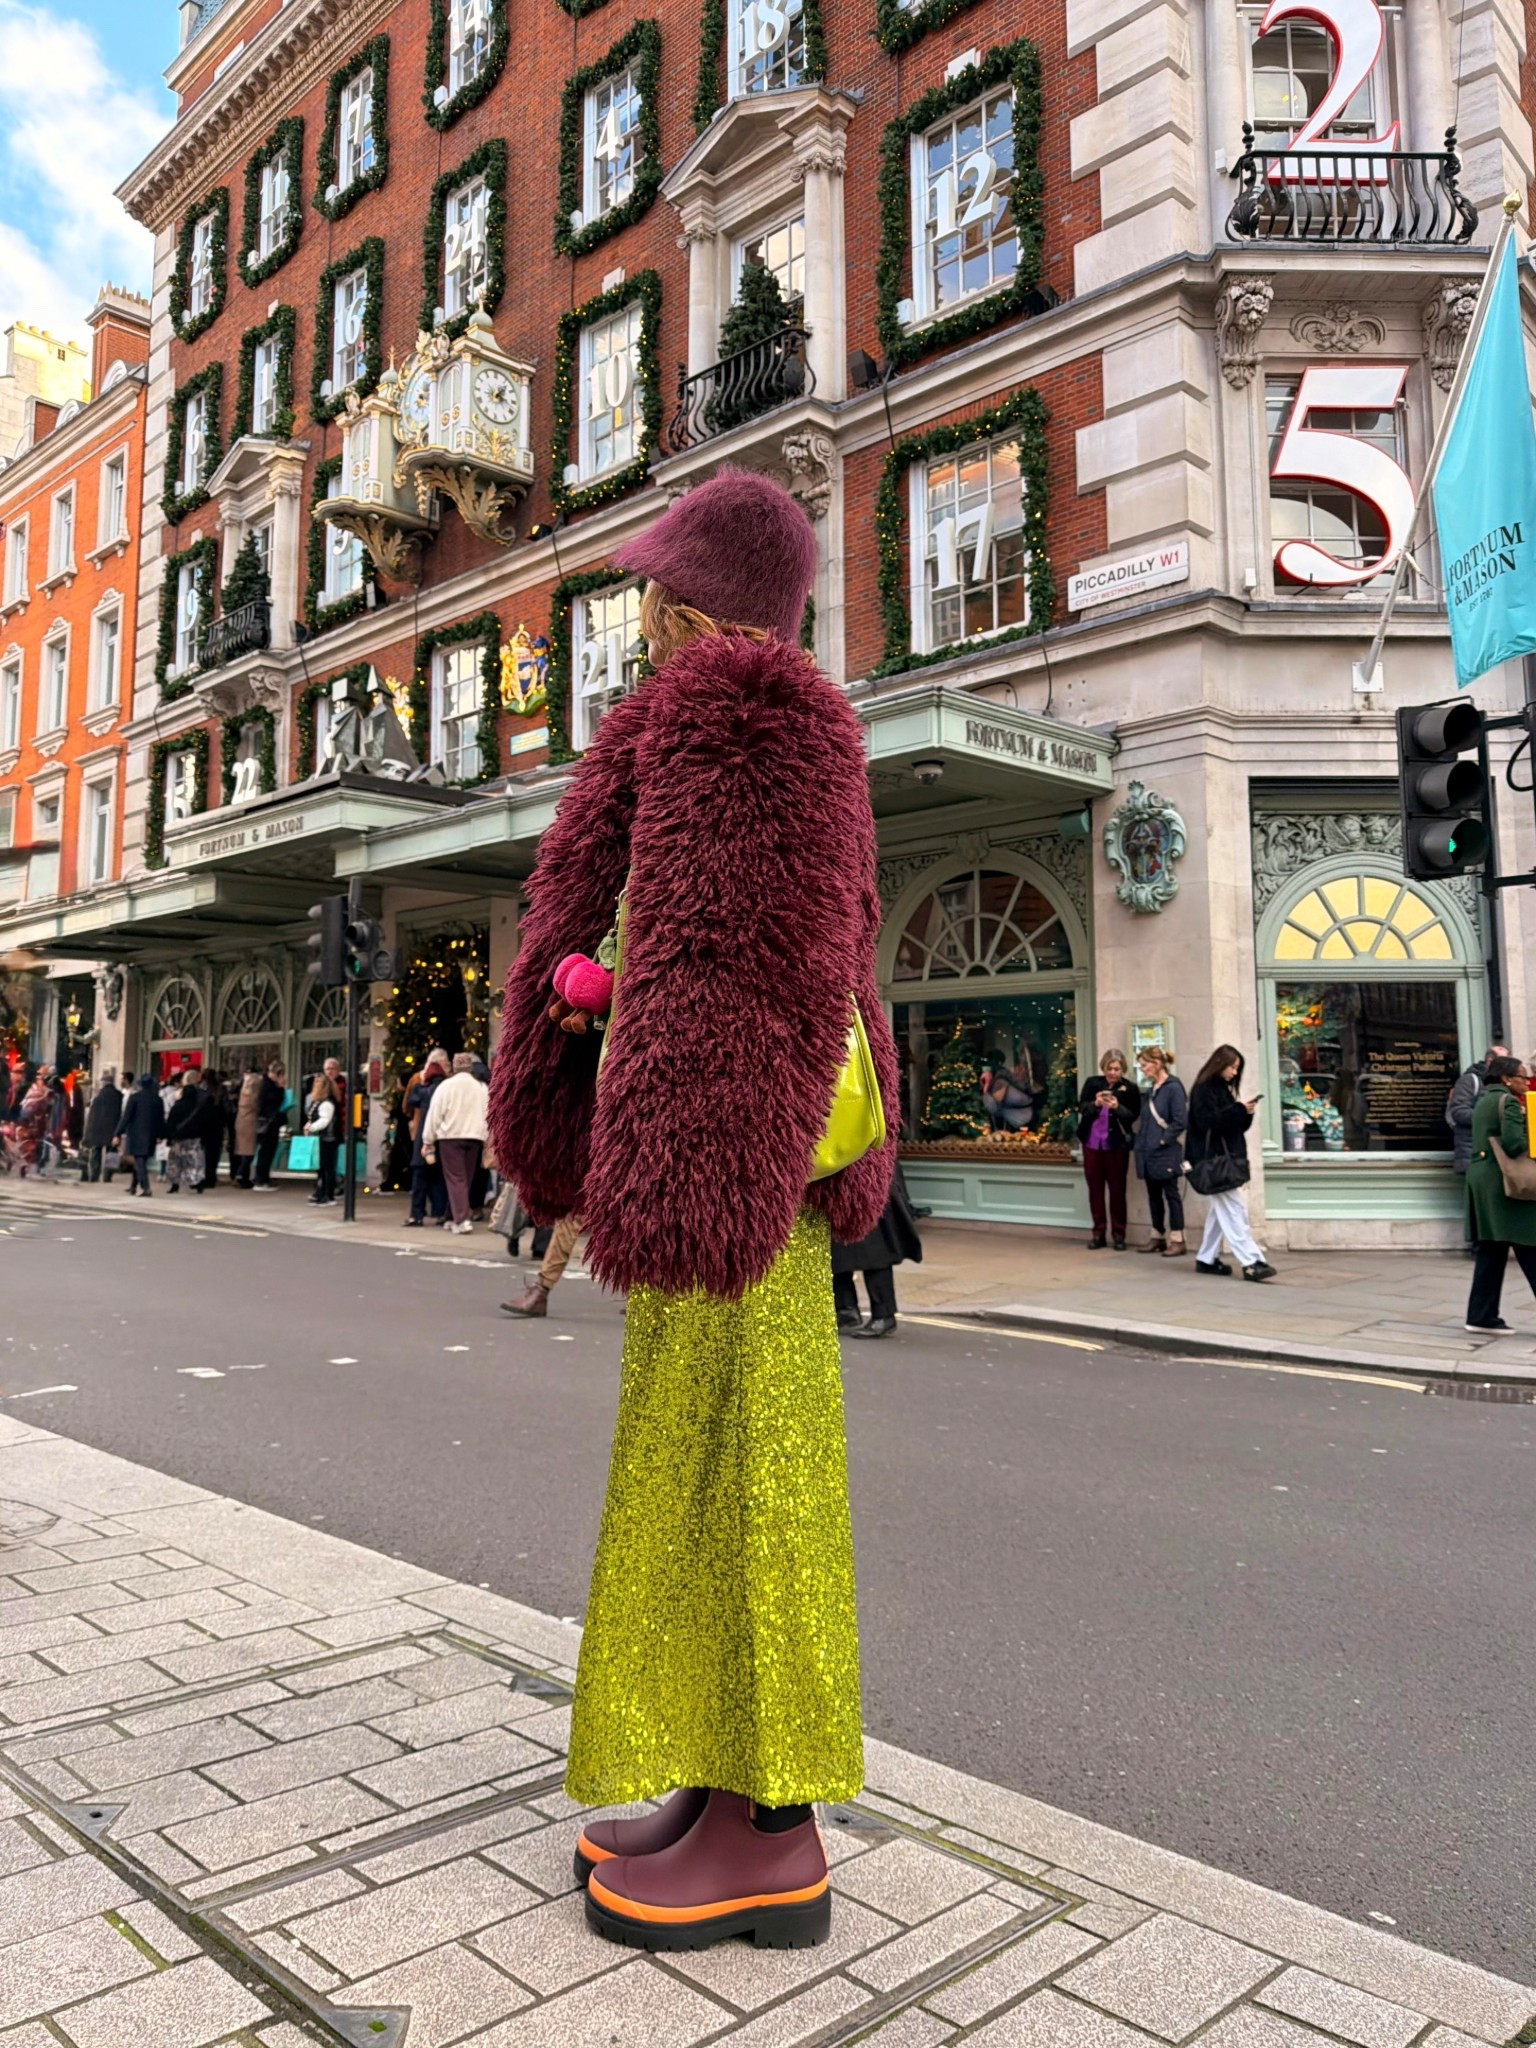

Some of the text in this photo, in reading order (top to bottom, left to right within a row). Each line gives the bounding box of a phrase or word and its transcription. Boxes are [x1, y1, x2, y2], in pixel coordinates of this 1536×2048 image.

[347, 94, 364, 146] 7
[1258, 0, 1400, 187] 2
[595, 106, 623, 162] 4
[928, 151, 997, 243] 12
[443, 204, 485, 274] 24
[334, 296, 364, 352] 16
[259, 362, 273, 405] 1
[585, 351, 631, 420] 10
[189, 413, 203, 456] 6
[1271, 365, 1418, 587] 5
[928, 502, 993, 592] 17
[1075, 550, 1180, 594] PICCADILLY W1
[1448, 521, 1526, 588] FORTNUM
[1462, 548, 1516, 601] MASON
[179, 588, 200, 634] 9
[1075, 580, 1146, 607] CITY OF WESTMINSTER
[580, 633, 628, 698] 21
[231, 757, 261, 805] 22
[252, 828, 260, 842] &
[266, 815, 304, 839] MASON
